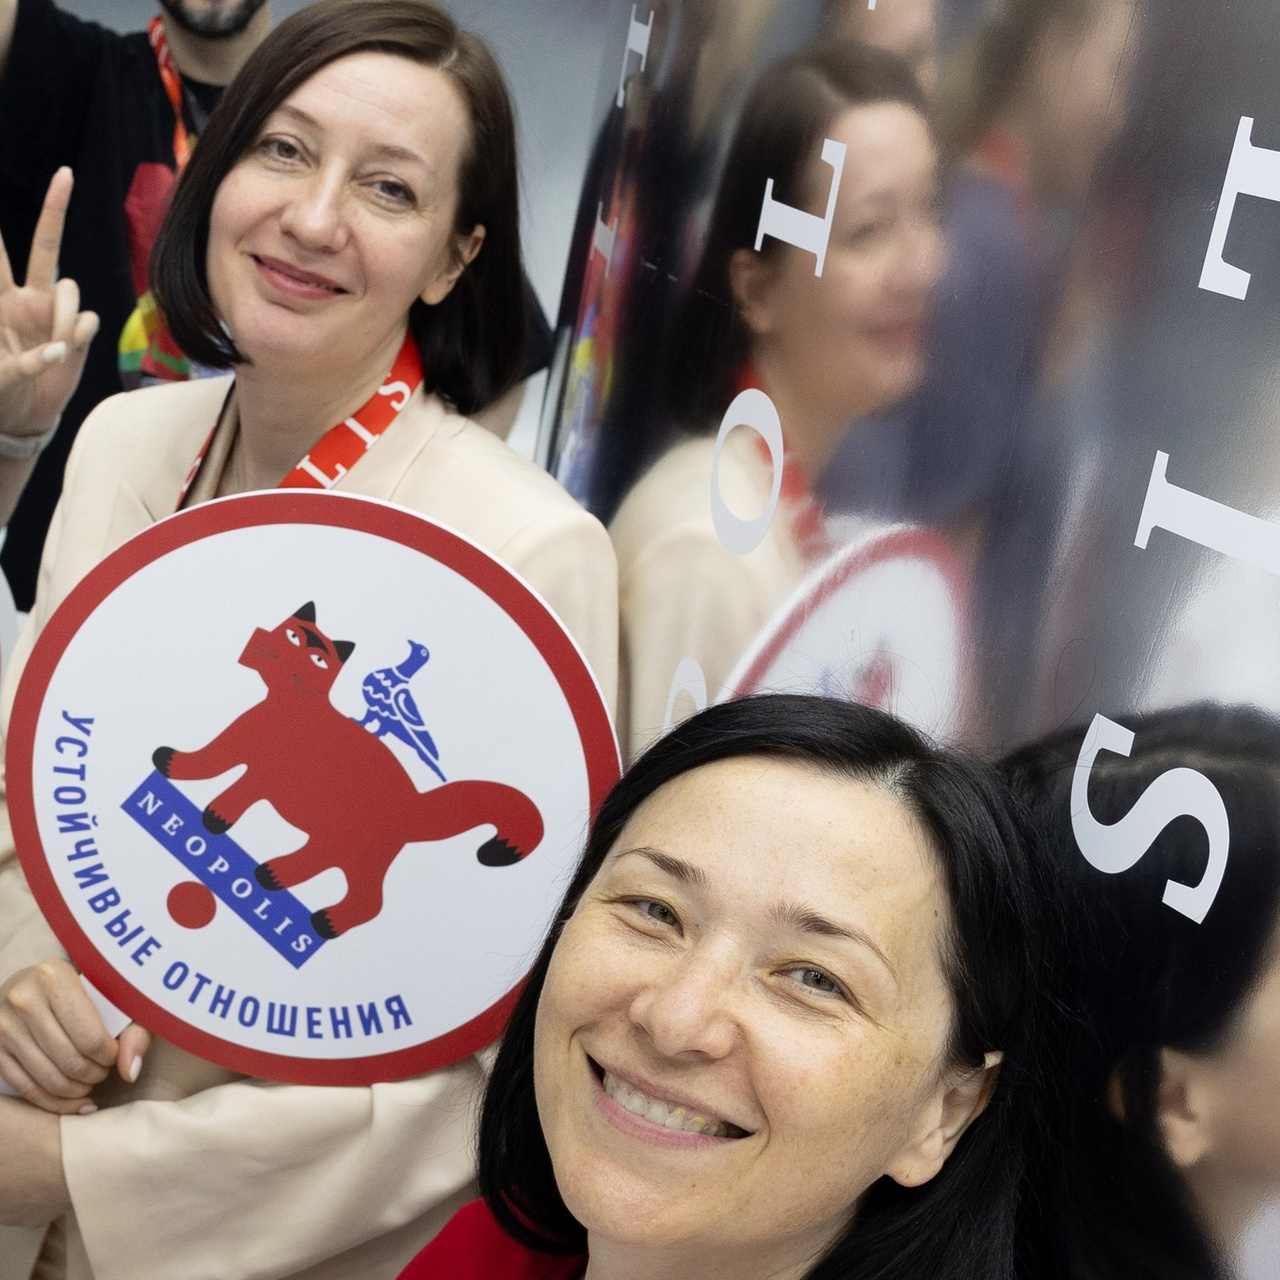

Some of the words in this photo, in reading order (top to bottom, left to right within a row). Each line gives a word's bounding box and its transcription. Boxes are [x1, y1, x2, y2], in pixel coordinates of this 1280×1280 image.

[52, 709, 162, 968] УСТОЙЧИВЫЕ
[162, 960, 413, 1040] ОТНОШЕНИЯ
[136, 790, 314, 955] NEOPOLIS
